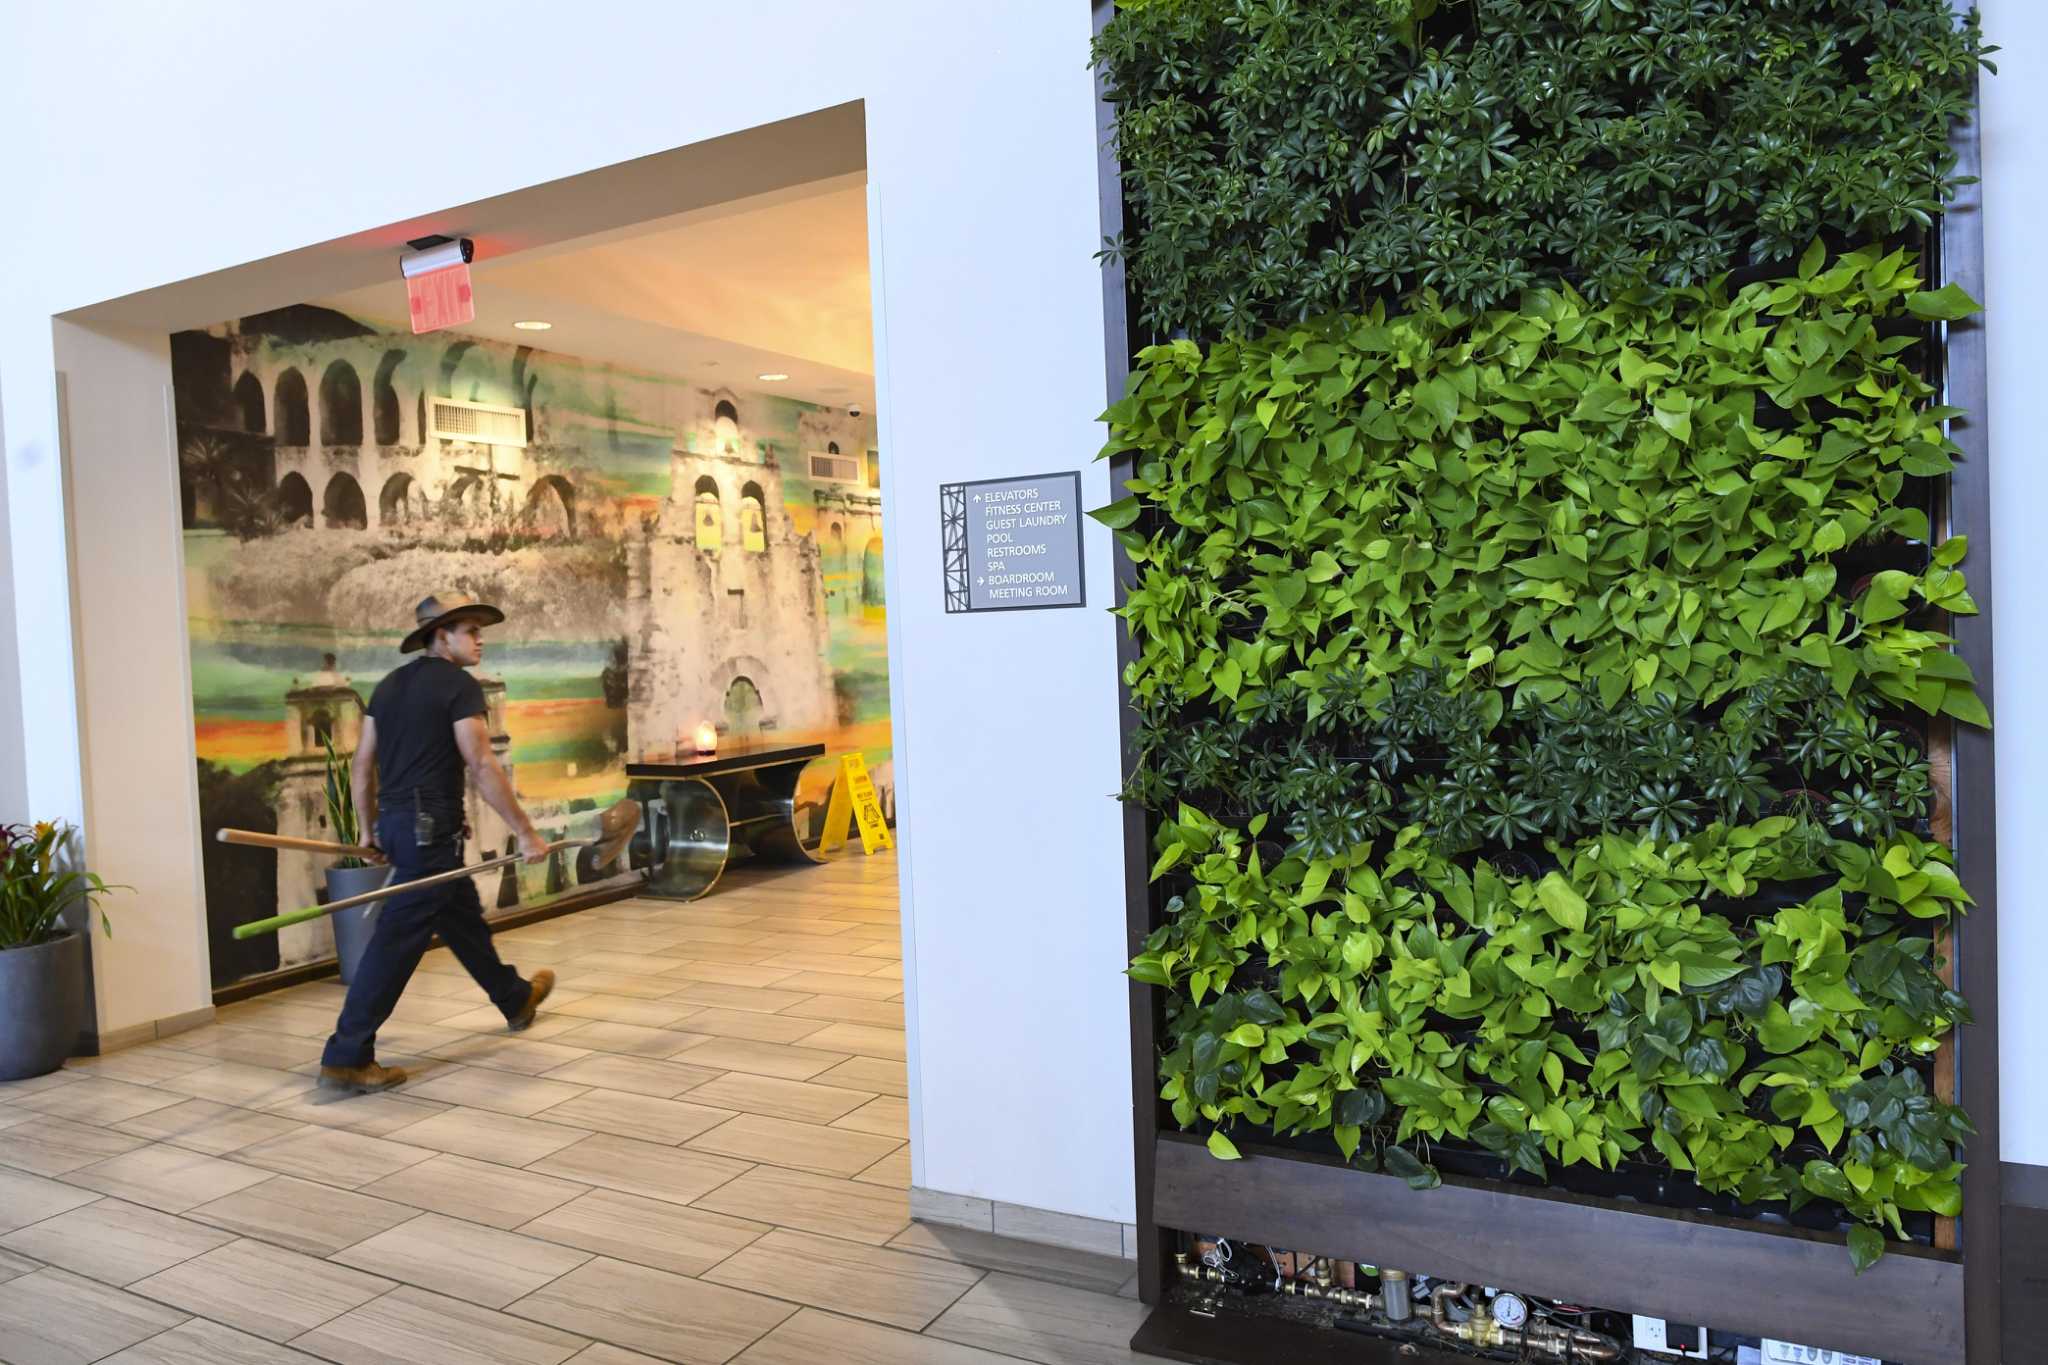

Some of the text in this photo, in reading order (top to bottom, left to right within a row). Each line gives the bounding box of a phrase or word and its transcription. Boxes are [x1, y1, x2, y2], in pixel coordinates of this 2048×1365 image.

[985, 489, 1038, 502] ELEVATORS
[985, 500, 1061, 516] FITNESS CENTER
[986, 513, 1067, 530] GUEST LAUNDRY
[986, 532, 1013, 544] POOL
[987, 544, 1046, 558] RESTROOMS
[987, 561, 1006, 571] SPA
[989, 571, 1055, 585] BOARDROOM
[989, 585, 1068, 600] MEETING ROOM
